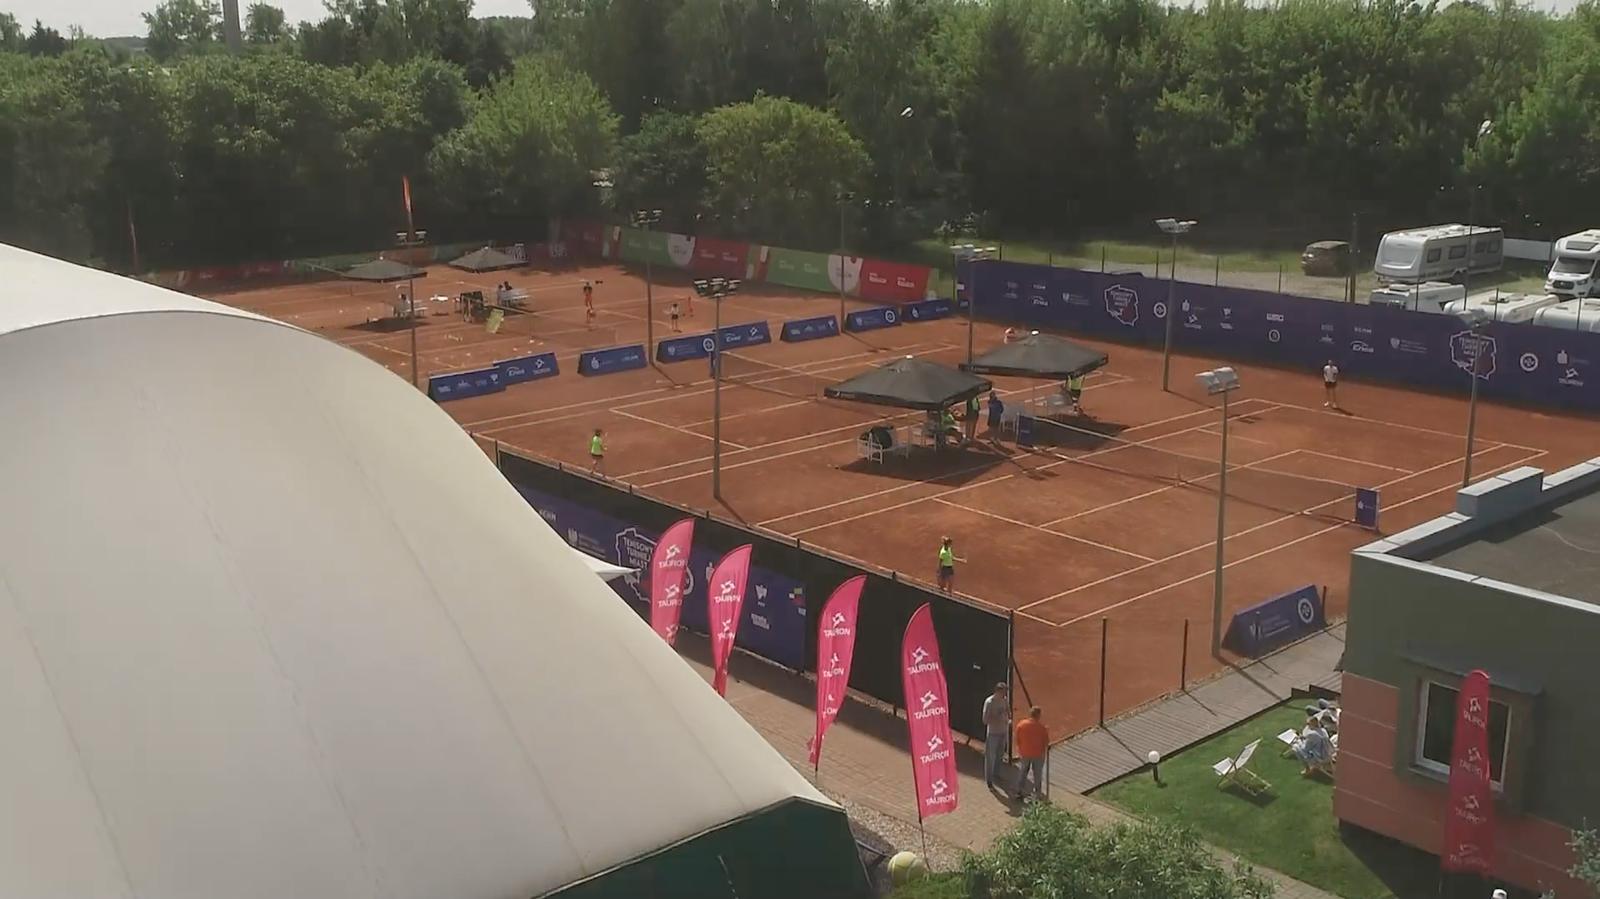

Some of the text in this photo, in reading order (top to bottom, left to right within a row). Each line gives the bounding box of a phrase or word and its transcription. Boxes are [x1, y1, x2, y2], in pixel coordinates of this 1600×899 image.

[907, 662, 939, 674] TAURON
[913, 706, 947, 720] TAURON
[920, 749, 950, 764] TAURON
[926, 793, 955, 806] TAURON
